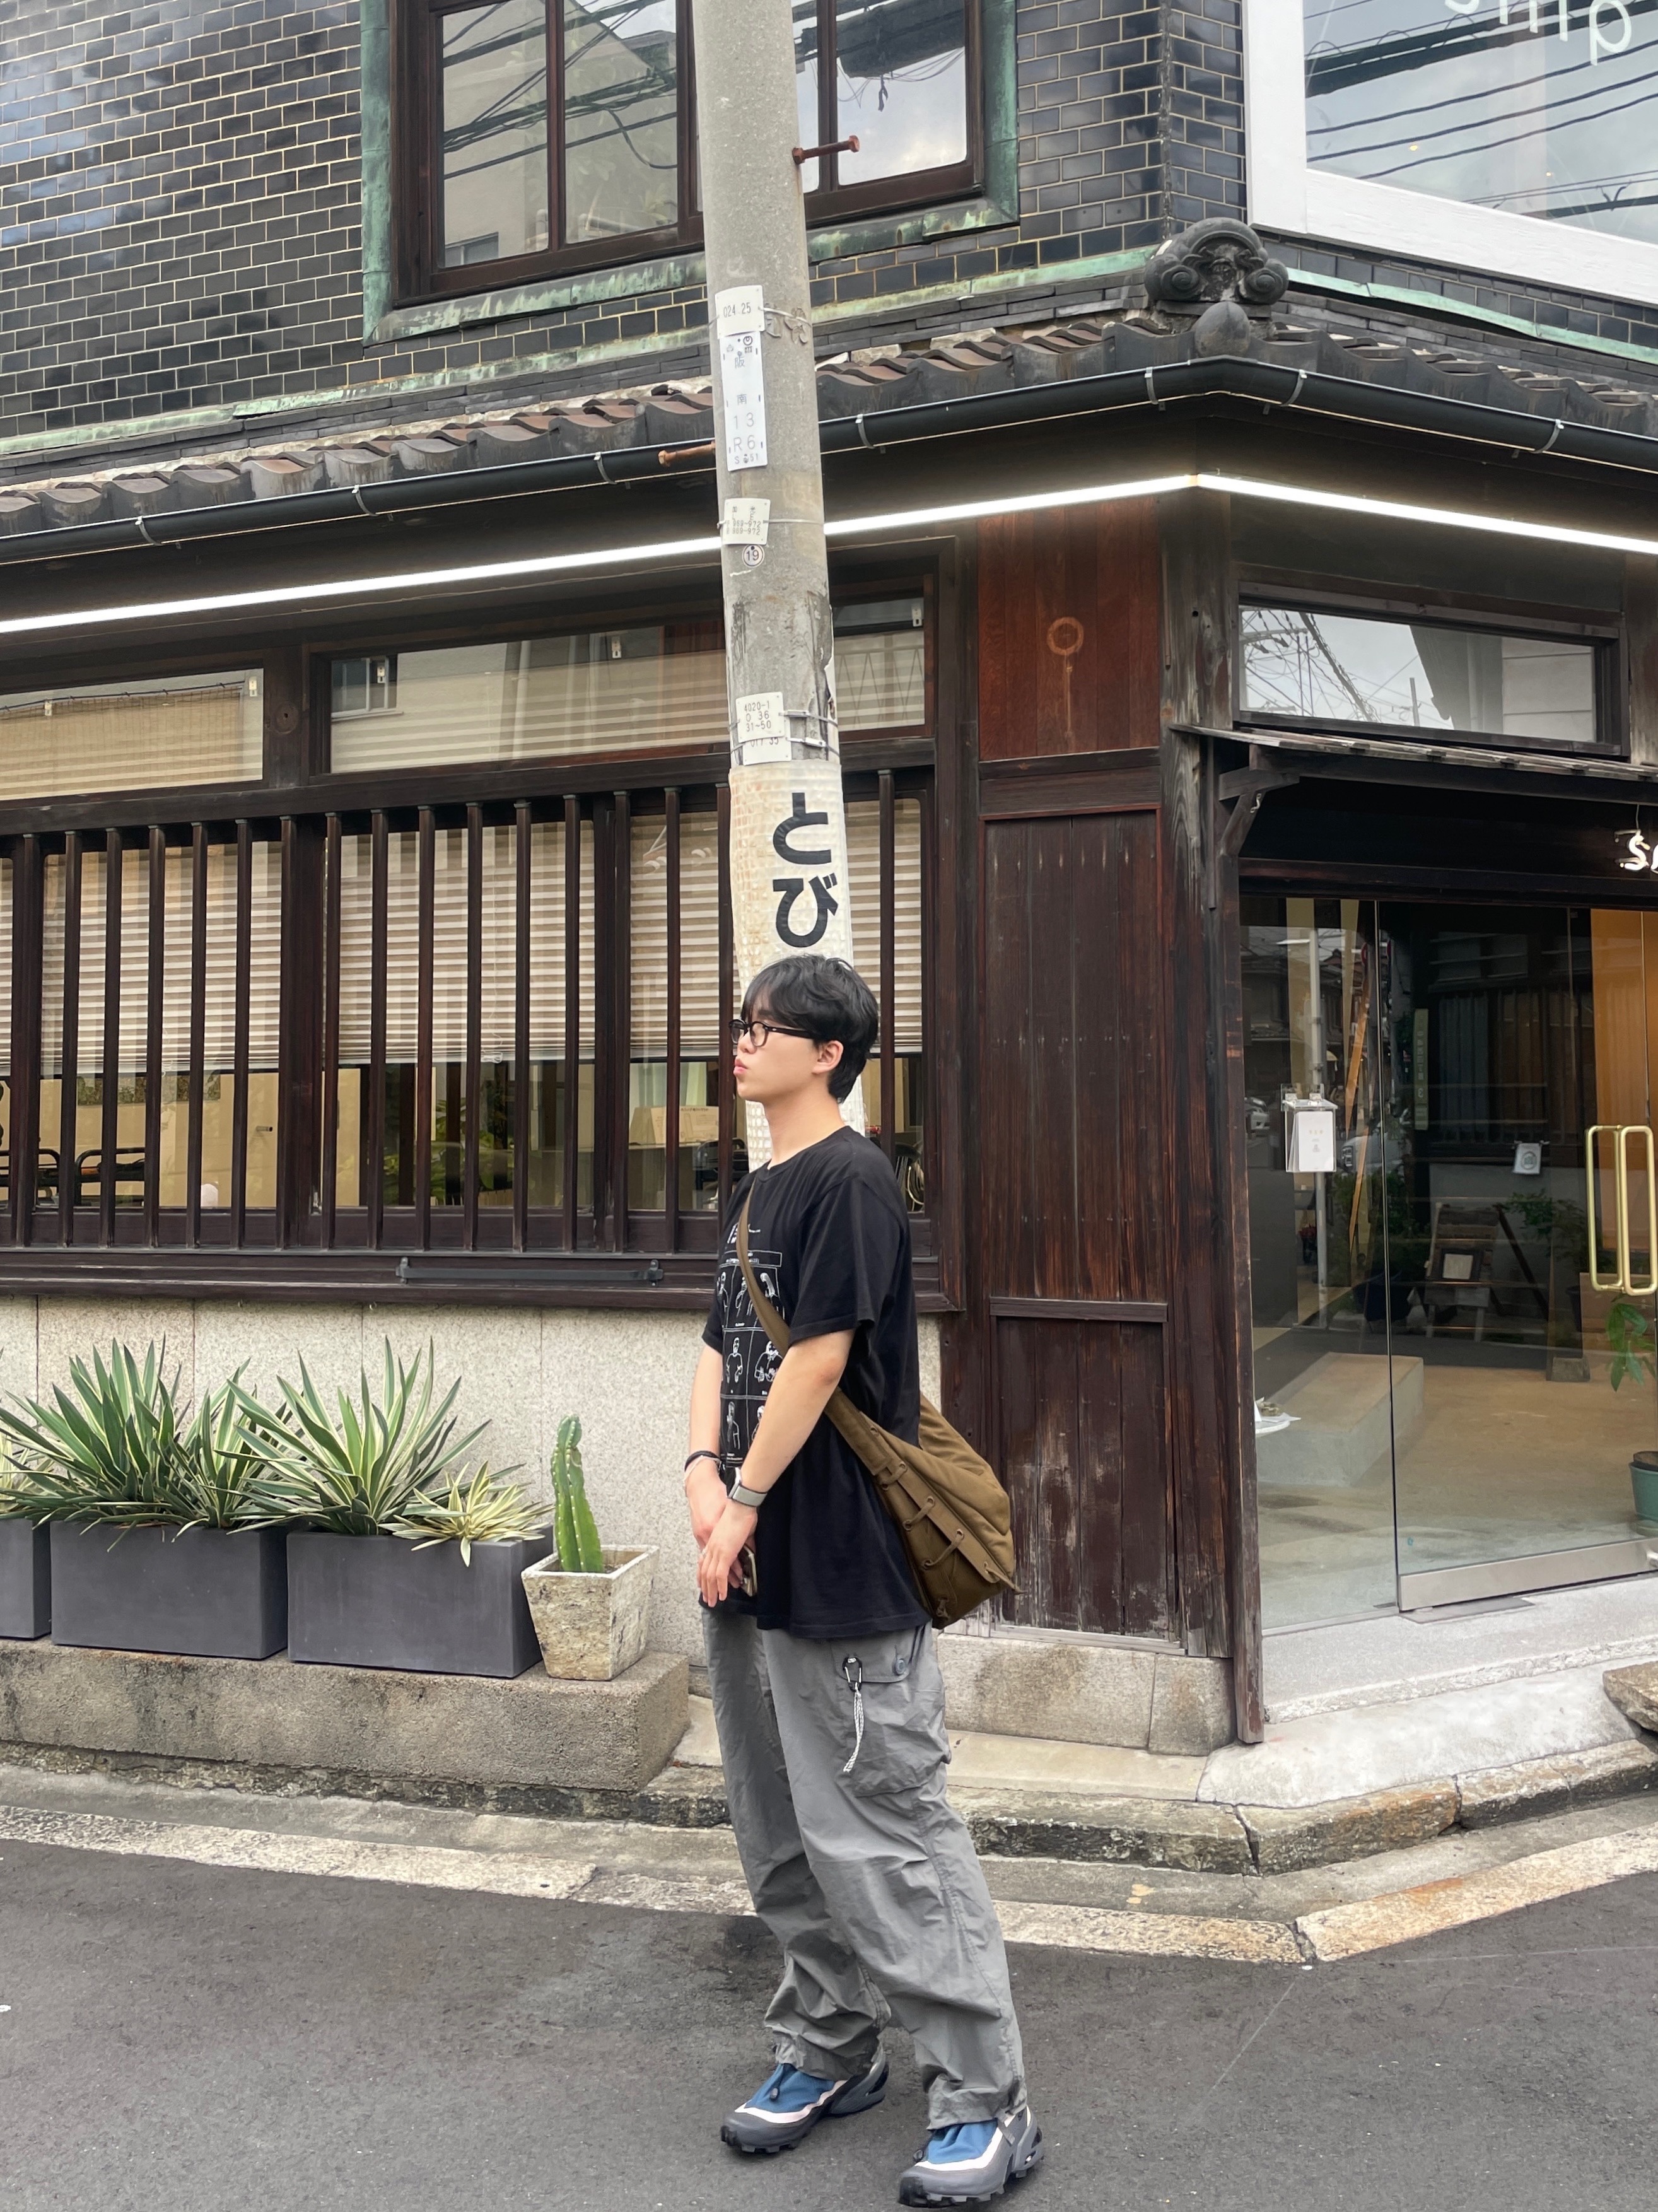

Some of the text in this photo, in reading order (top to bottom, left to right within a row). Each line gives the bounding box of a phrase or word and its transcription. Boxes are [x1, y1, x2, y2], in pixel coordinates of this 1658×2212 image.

[737, 394, 747, 405] 南
[745, 550, 759, 561] 19
[744, 700, 769, 711] 4020-1
[758, 711, 769, 720] 36
[772, 792, 839, 948] とび
